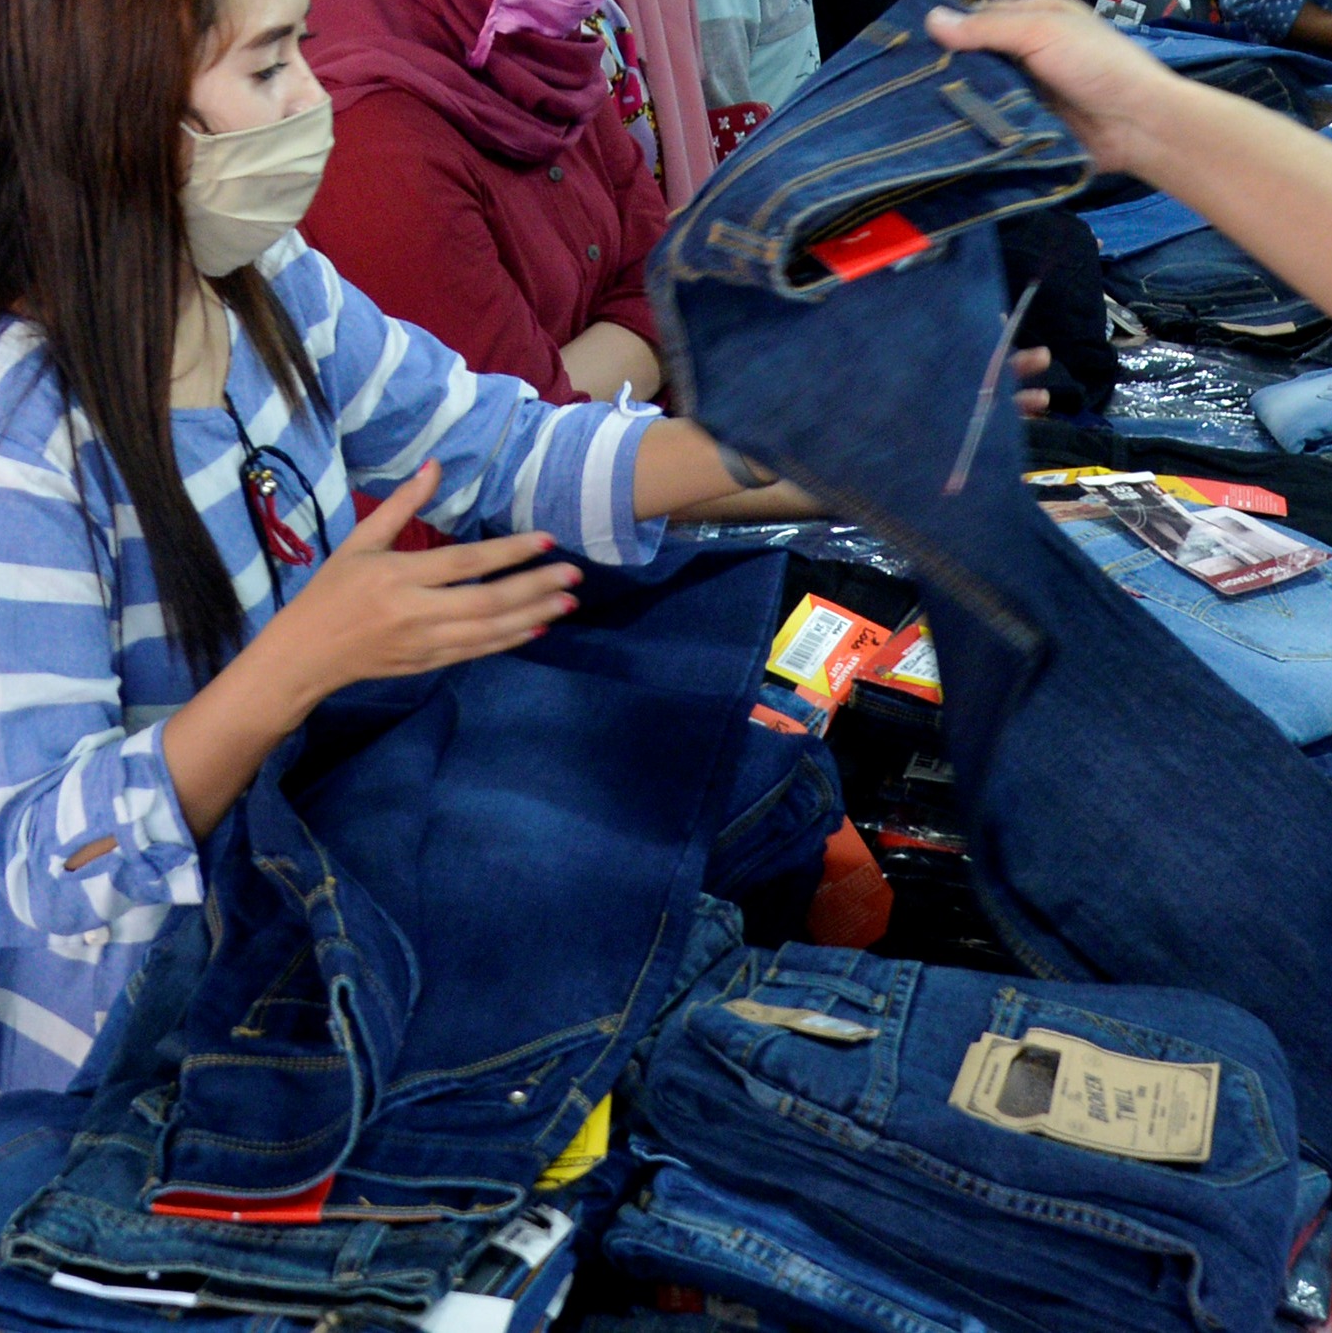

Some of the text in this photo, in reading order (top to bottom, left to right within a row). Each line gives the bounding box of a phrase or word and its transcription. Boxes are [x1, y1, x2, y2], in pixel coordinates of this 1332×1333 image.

[830, 662, 845, 678] CUT
[831, 655, 861, 693] STRAIGHT
[1084, 1071, 1110, 1124] BROKEN
[1114, 1087, 1138, 1122] TWILL
